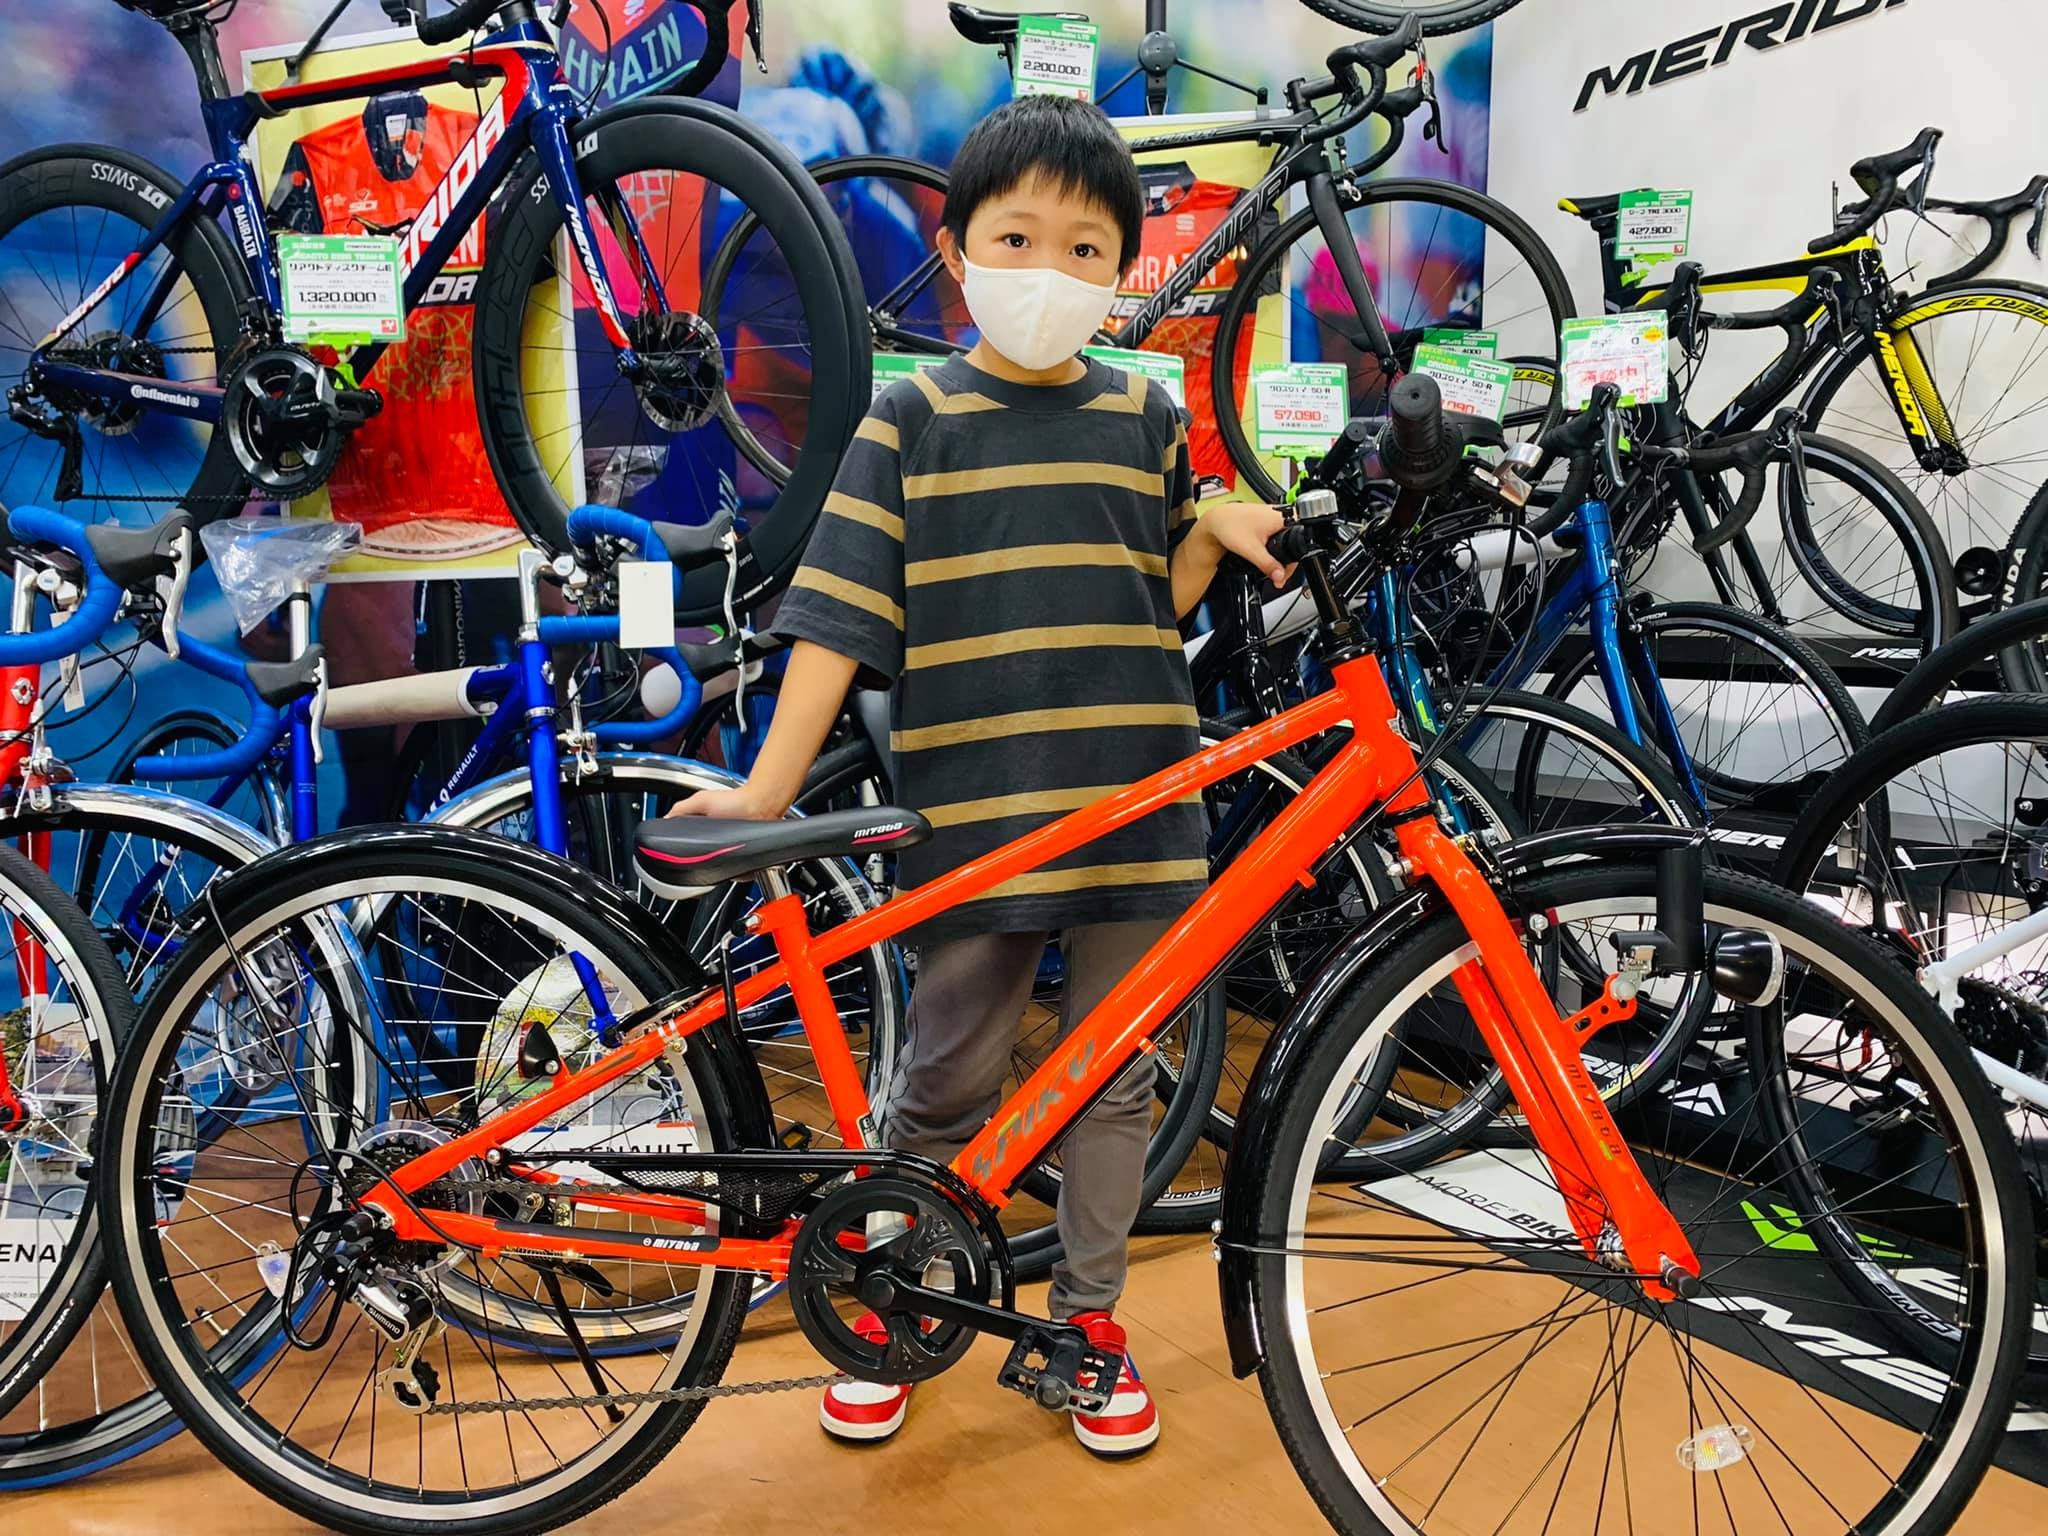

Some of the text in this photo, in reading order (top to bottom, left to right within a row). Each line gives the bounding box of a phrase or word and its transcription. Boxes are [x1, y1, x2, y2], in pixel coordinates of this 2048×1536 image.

[1573, 0, 1906, 112] MERID
[90, 162, 139, 192] SWISS
[138, 184, 169, 210] DT
[399, 94, 507, 285] ERIDA
[232, 204, 260, 259] BAHRAIN
[1133, 165, 1290, 346] MERIDA
[565, 203, 614, 316] MERIDA
[1873, 330, 1928, 438] MERIDA
[447, 743, 479, 790] RENAULT
[1416, 1175, 1509, 1214] MORE
[367, 1306, 401, 1335] SHIMANO
